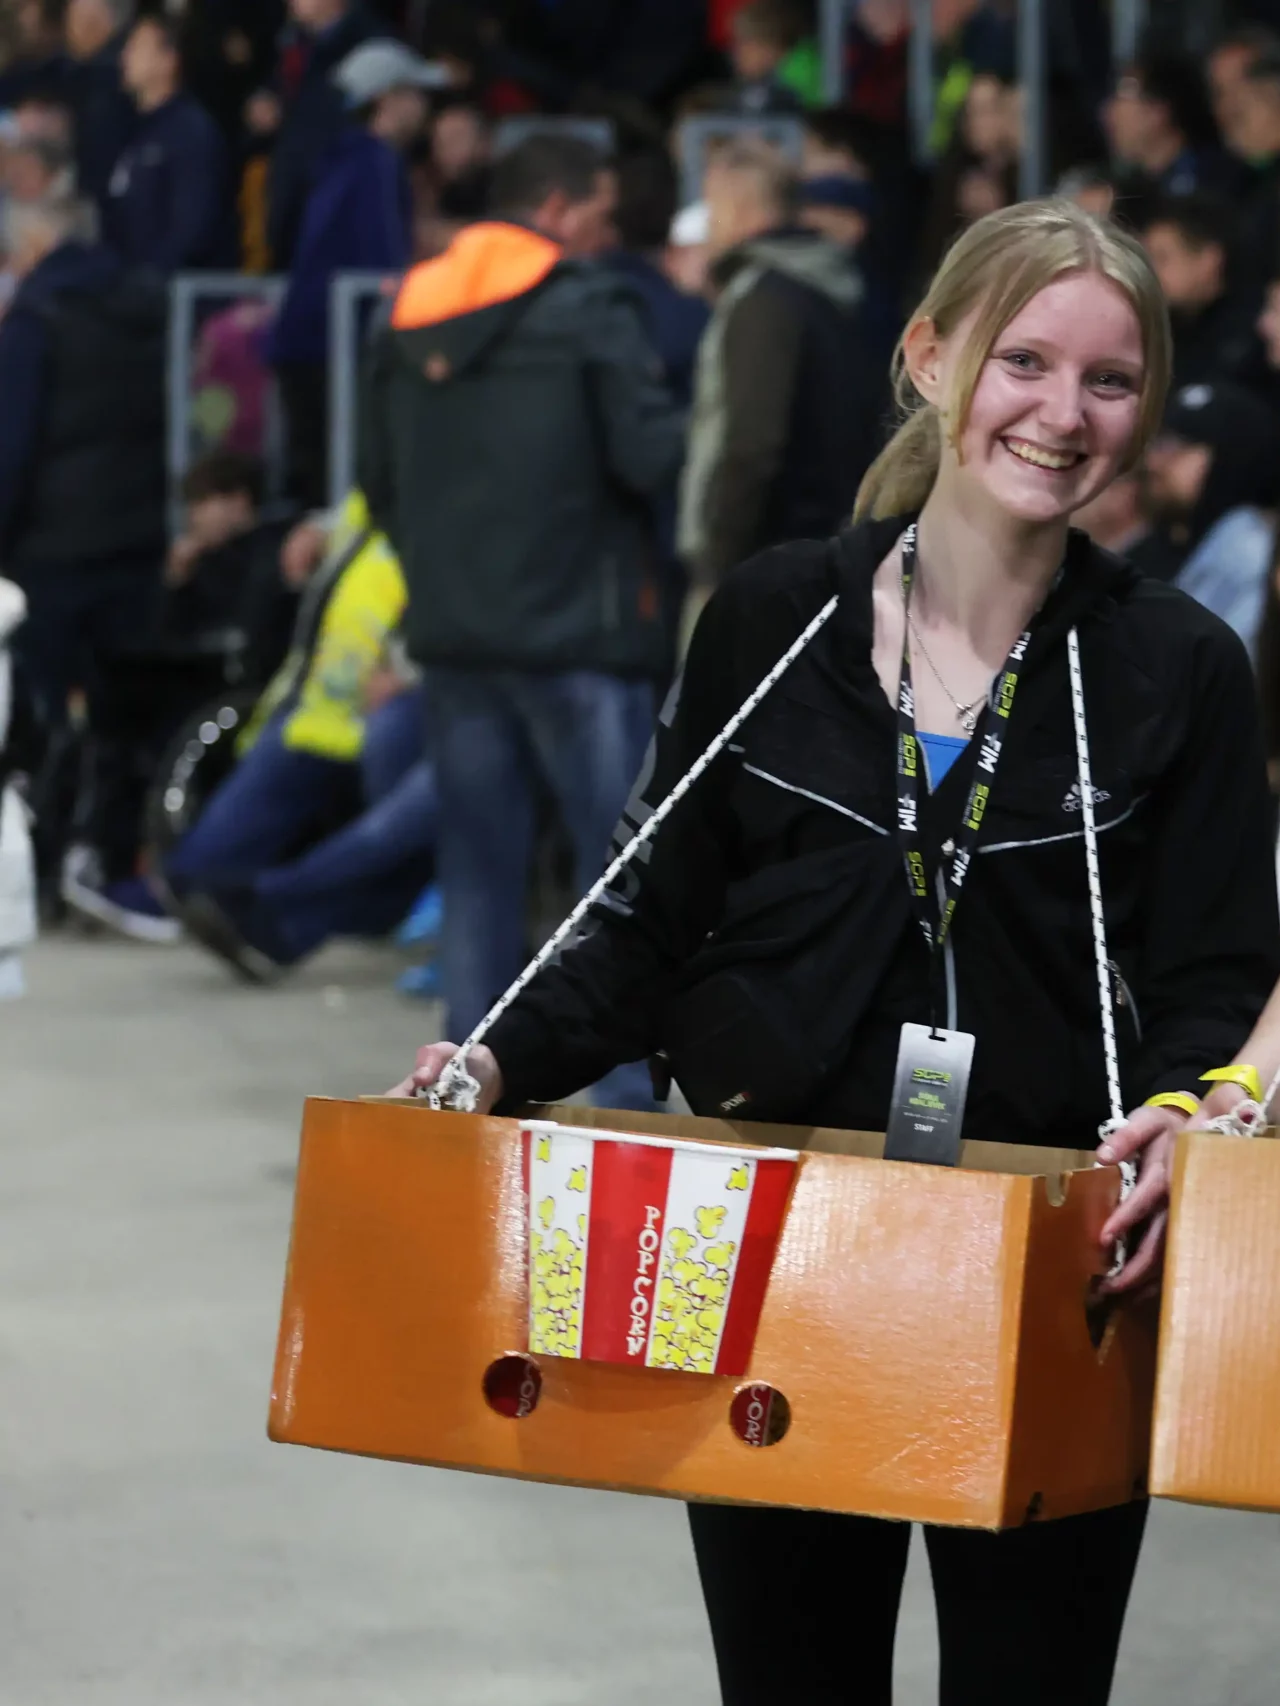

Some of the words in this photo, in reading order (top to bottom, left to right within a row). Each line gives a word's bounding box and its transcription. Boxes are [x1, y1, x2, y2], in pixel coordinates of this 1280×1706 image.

[1009, 632, 1031, 661] FIM
[900, 681, 915, 719] FIM
[977, 734, 1001, 774] FIM
[897, 794, 918, 832] FIM
[950, 846, 970, 887] FIM
[626, 1205, 661, 1356] POPCORN
[744, 1385, 763, 1446] COR
